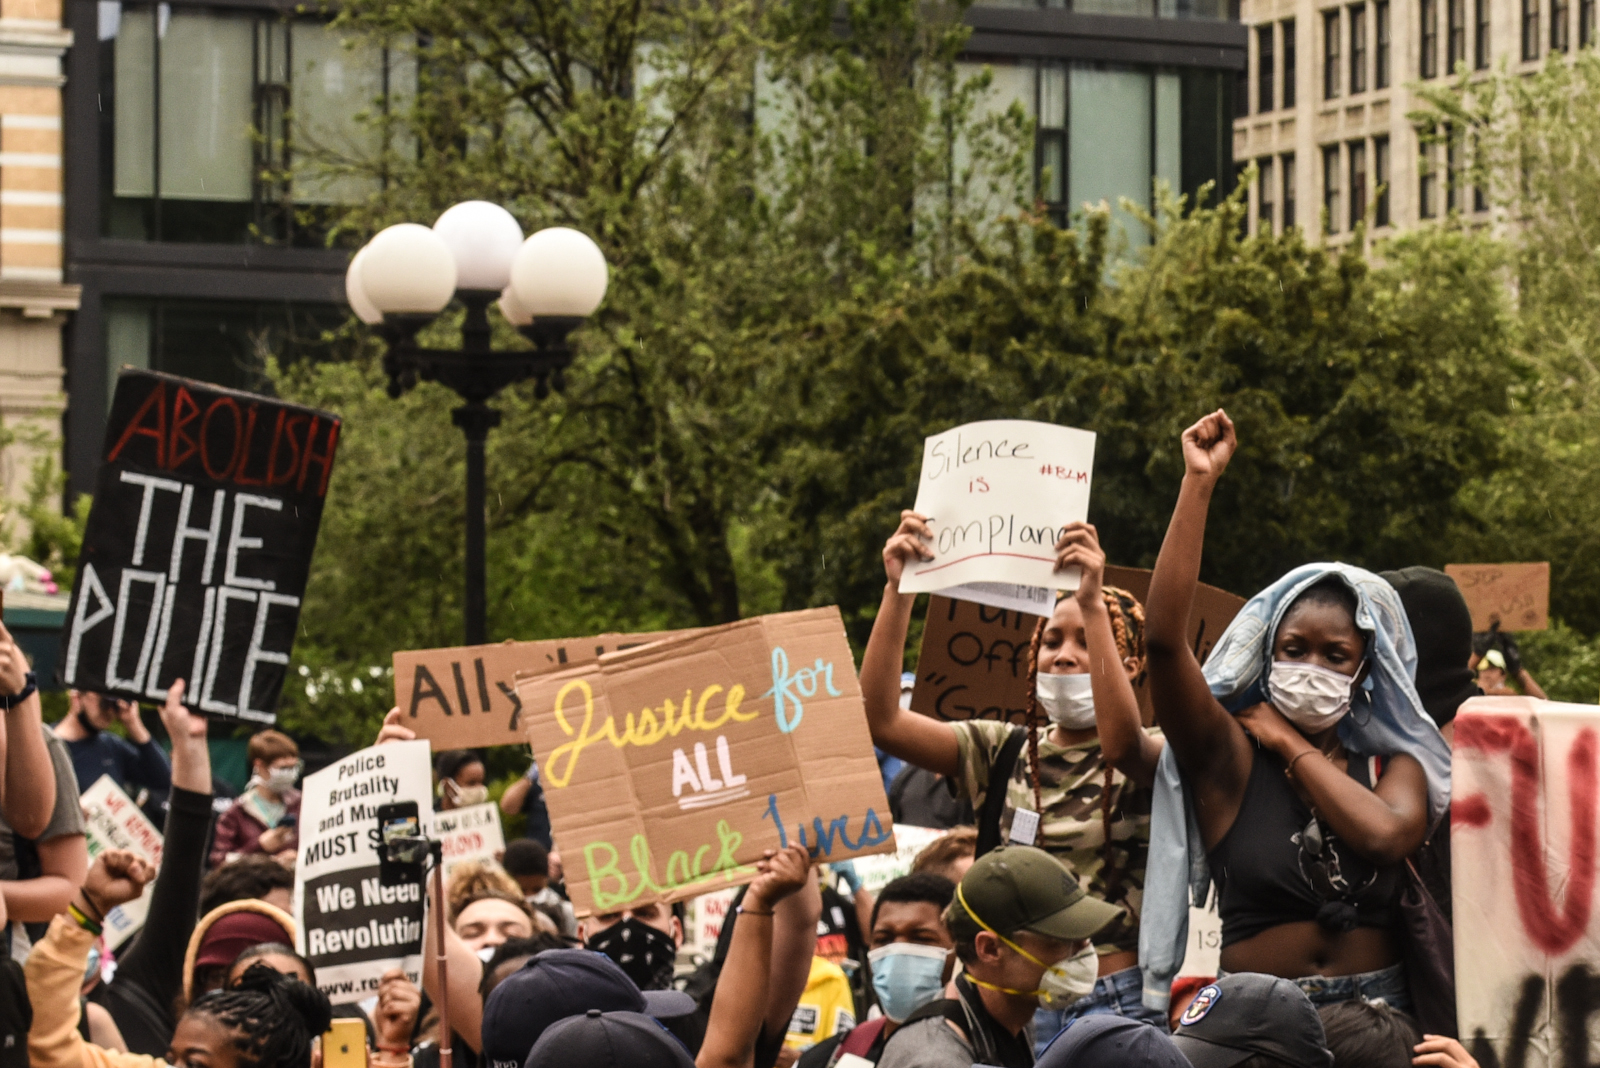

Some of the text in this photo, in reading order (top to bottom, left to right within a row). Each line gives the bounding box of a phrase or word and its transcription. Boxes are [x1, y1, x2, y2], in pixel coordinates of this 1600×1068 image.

[107, 380, 340, 497] ABOLISH
[928, 433, 1034, 480] Silence
[1039, 464, 1088, 484] #BLM
[120, 470, 282, 590] THE
[64, 562, 300, 725] POLICE
[544, 647, 842, 787] Justice for
[338, 754, 386, 780] Police
[671, 735, 747, 798] ALL
[329, 775, 399, 806] Brutality
[319, 809, 345, 833] and
[304, 831, 359, 867] MUST
[582, 818, 757, 910] Black
[316, 884, 357, 914] We
